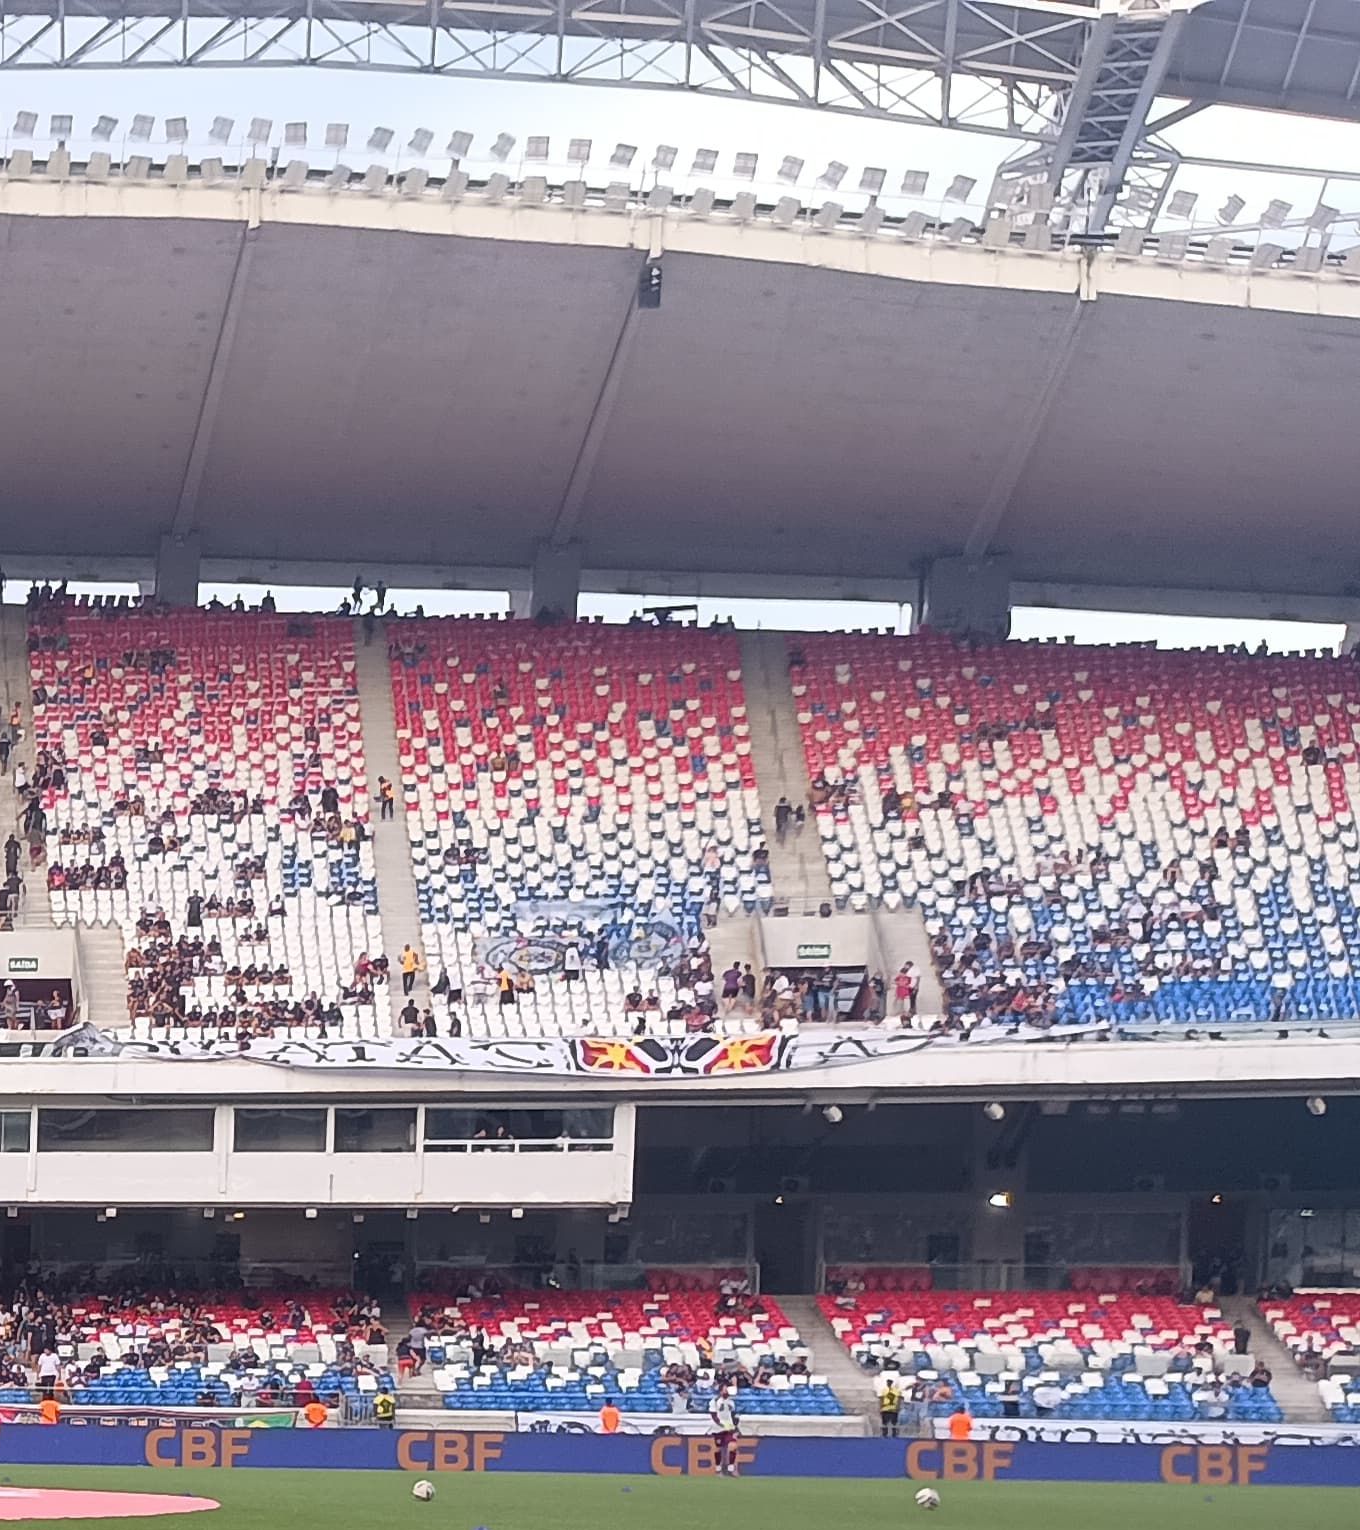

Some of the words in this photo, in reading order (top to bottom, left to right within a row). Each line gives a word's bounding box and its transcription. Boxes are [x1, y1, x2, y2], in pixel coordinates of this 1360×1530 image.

[144, 1428, 253, 1468] CBF
[396, 1432, 504, 1472] CBF
[651, 1436, 760, 1476] CBF
[906, 1440, 1015, 1481] CBF
[1161, 1445, 1269, 1486] CBF
